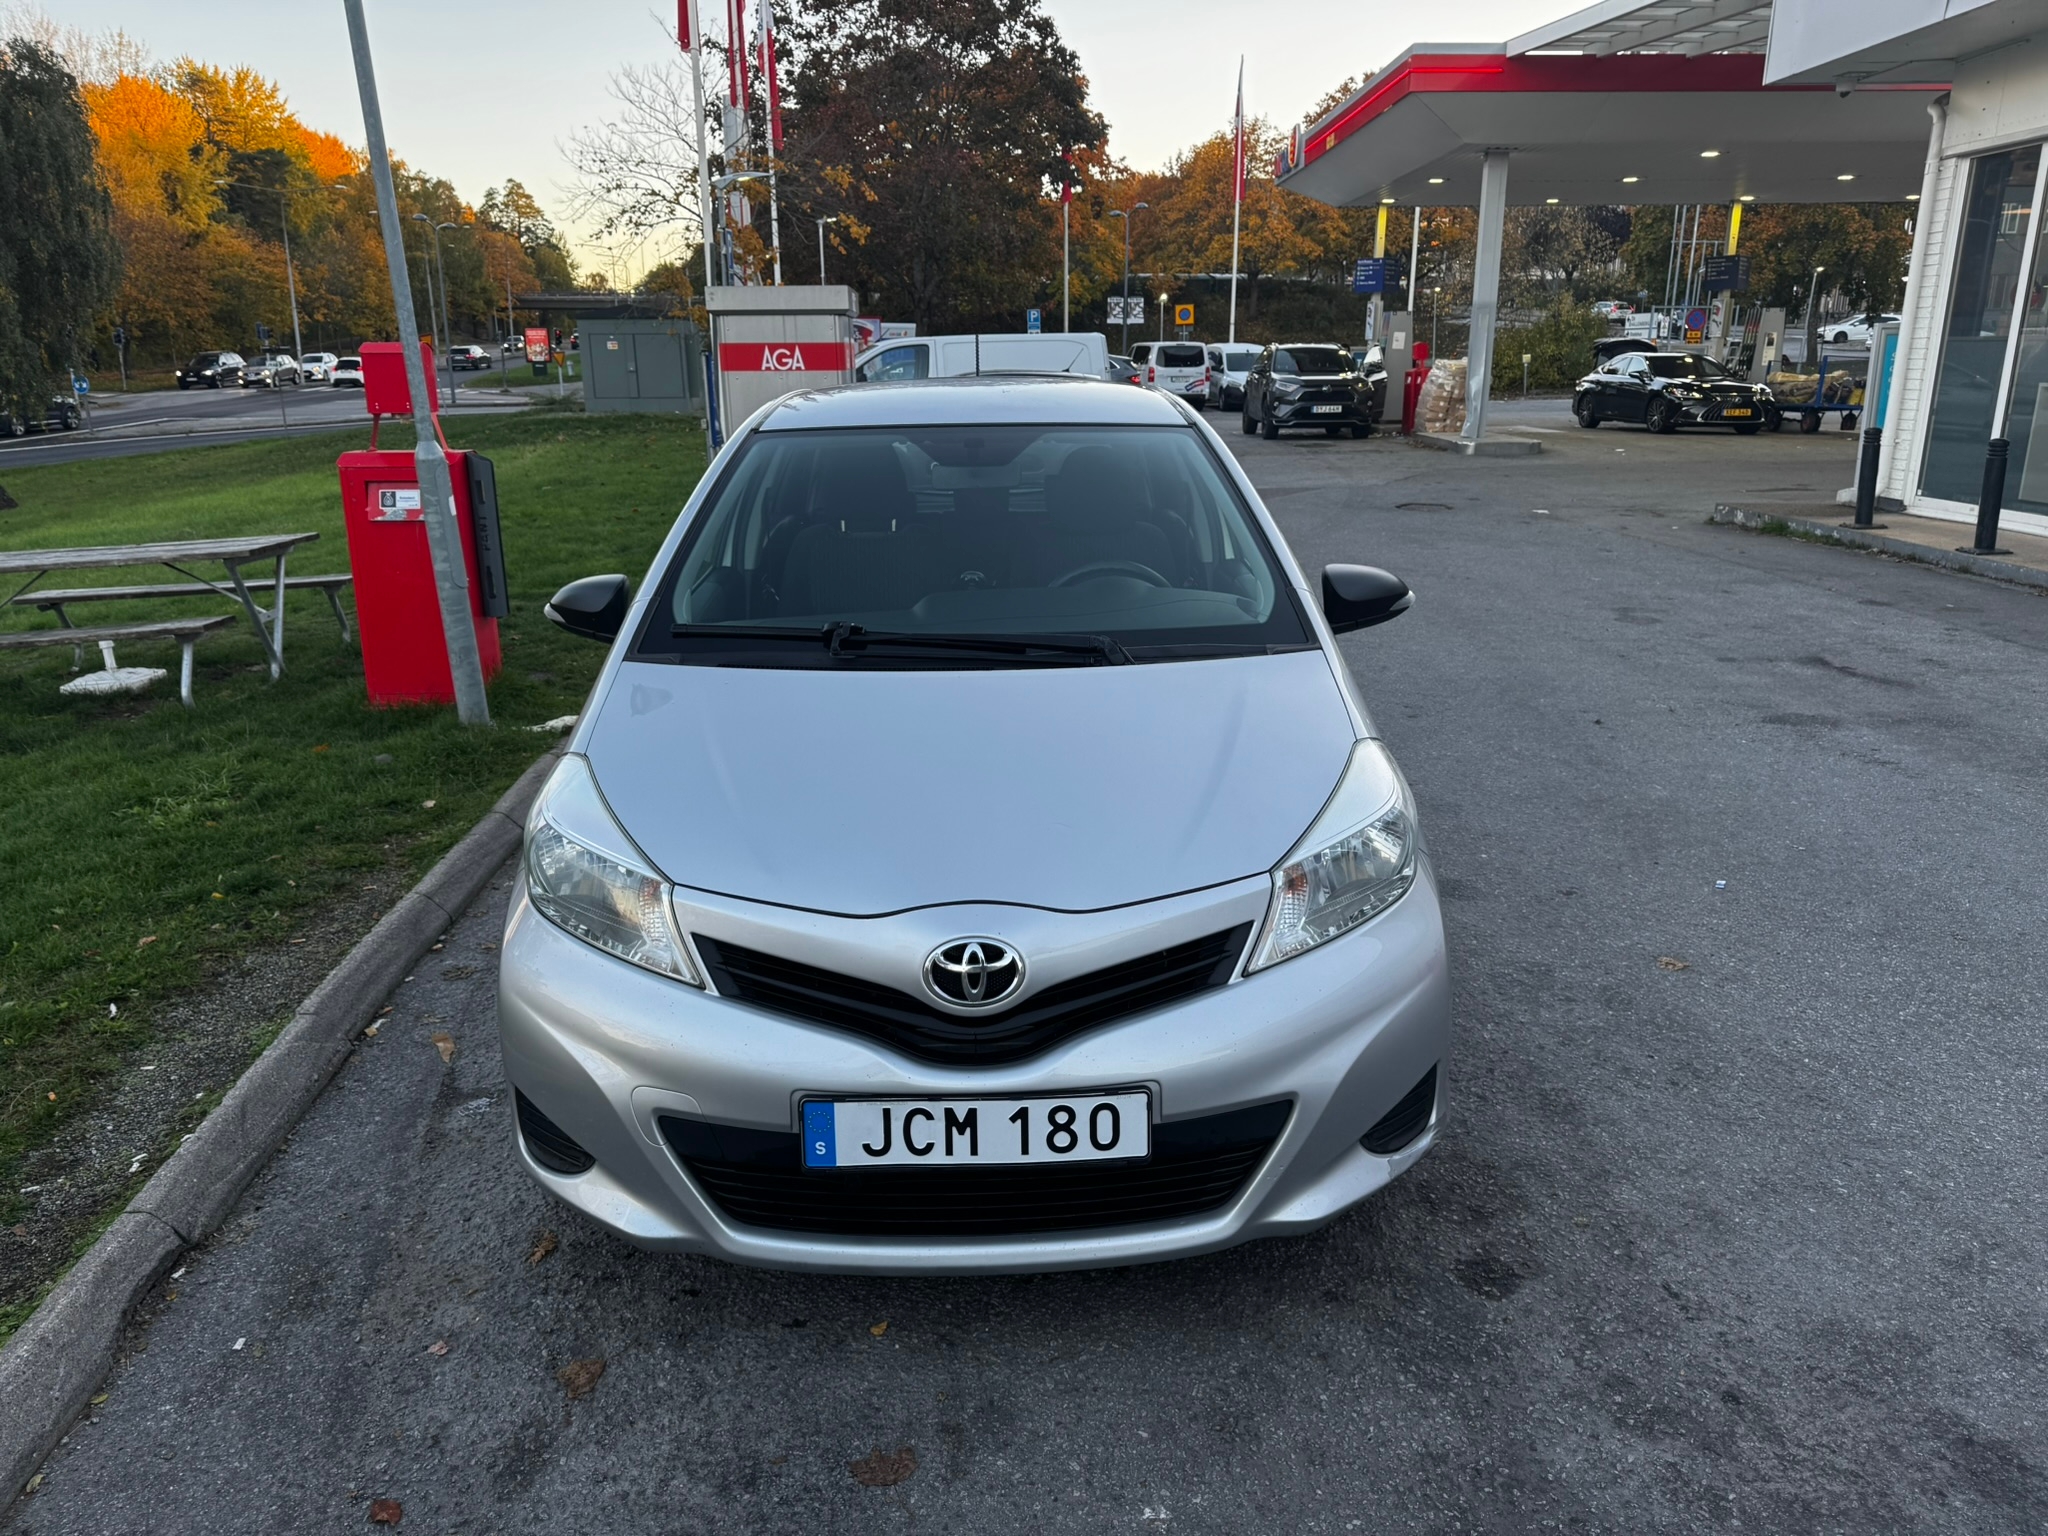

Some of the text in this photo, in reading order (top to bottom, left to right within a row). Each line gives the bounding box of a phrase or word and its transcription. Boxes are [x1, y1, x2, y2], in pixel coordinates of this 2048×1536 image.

[1030, 311, 1038, 322] P
[761, 344, 806, 370] AGA
[815, 1102, 1121, 1158] S JCM 180
